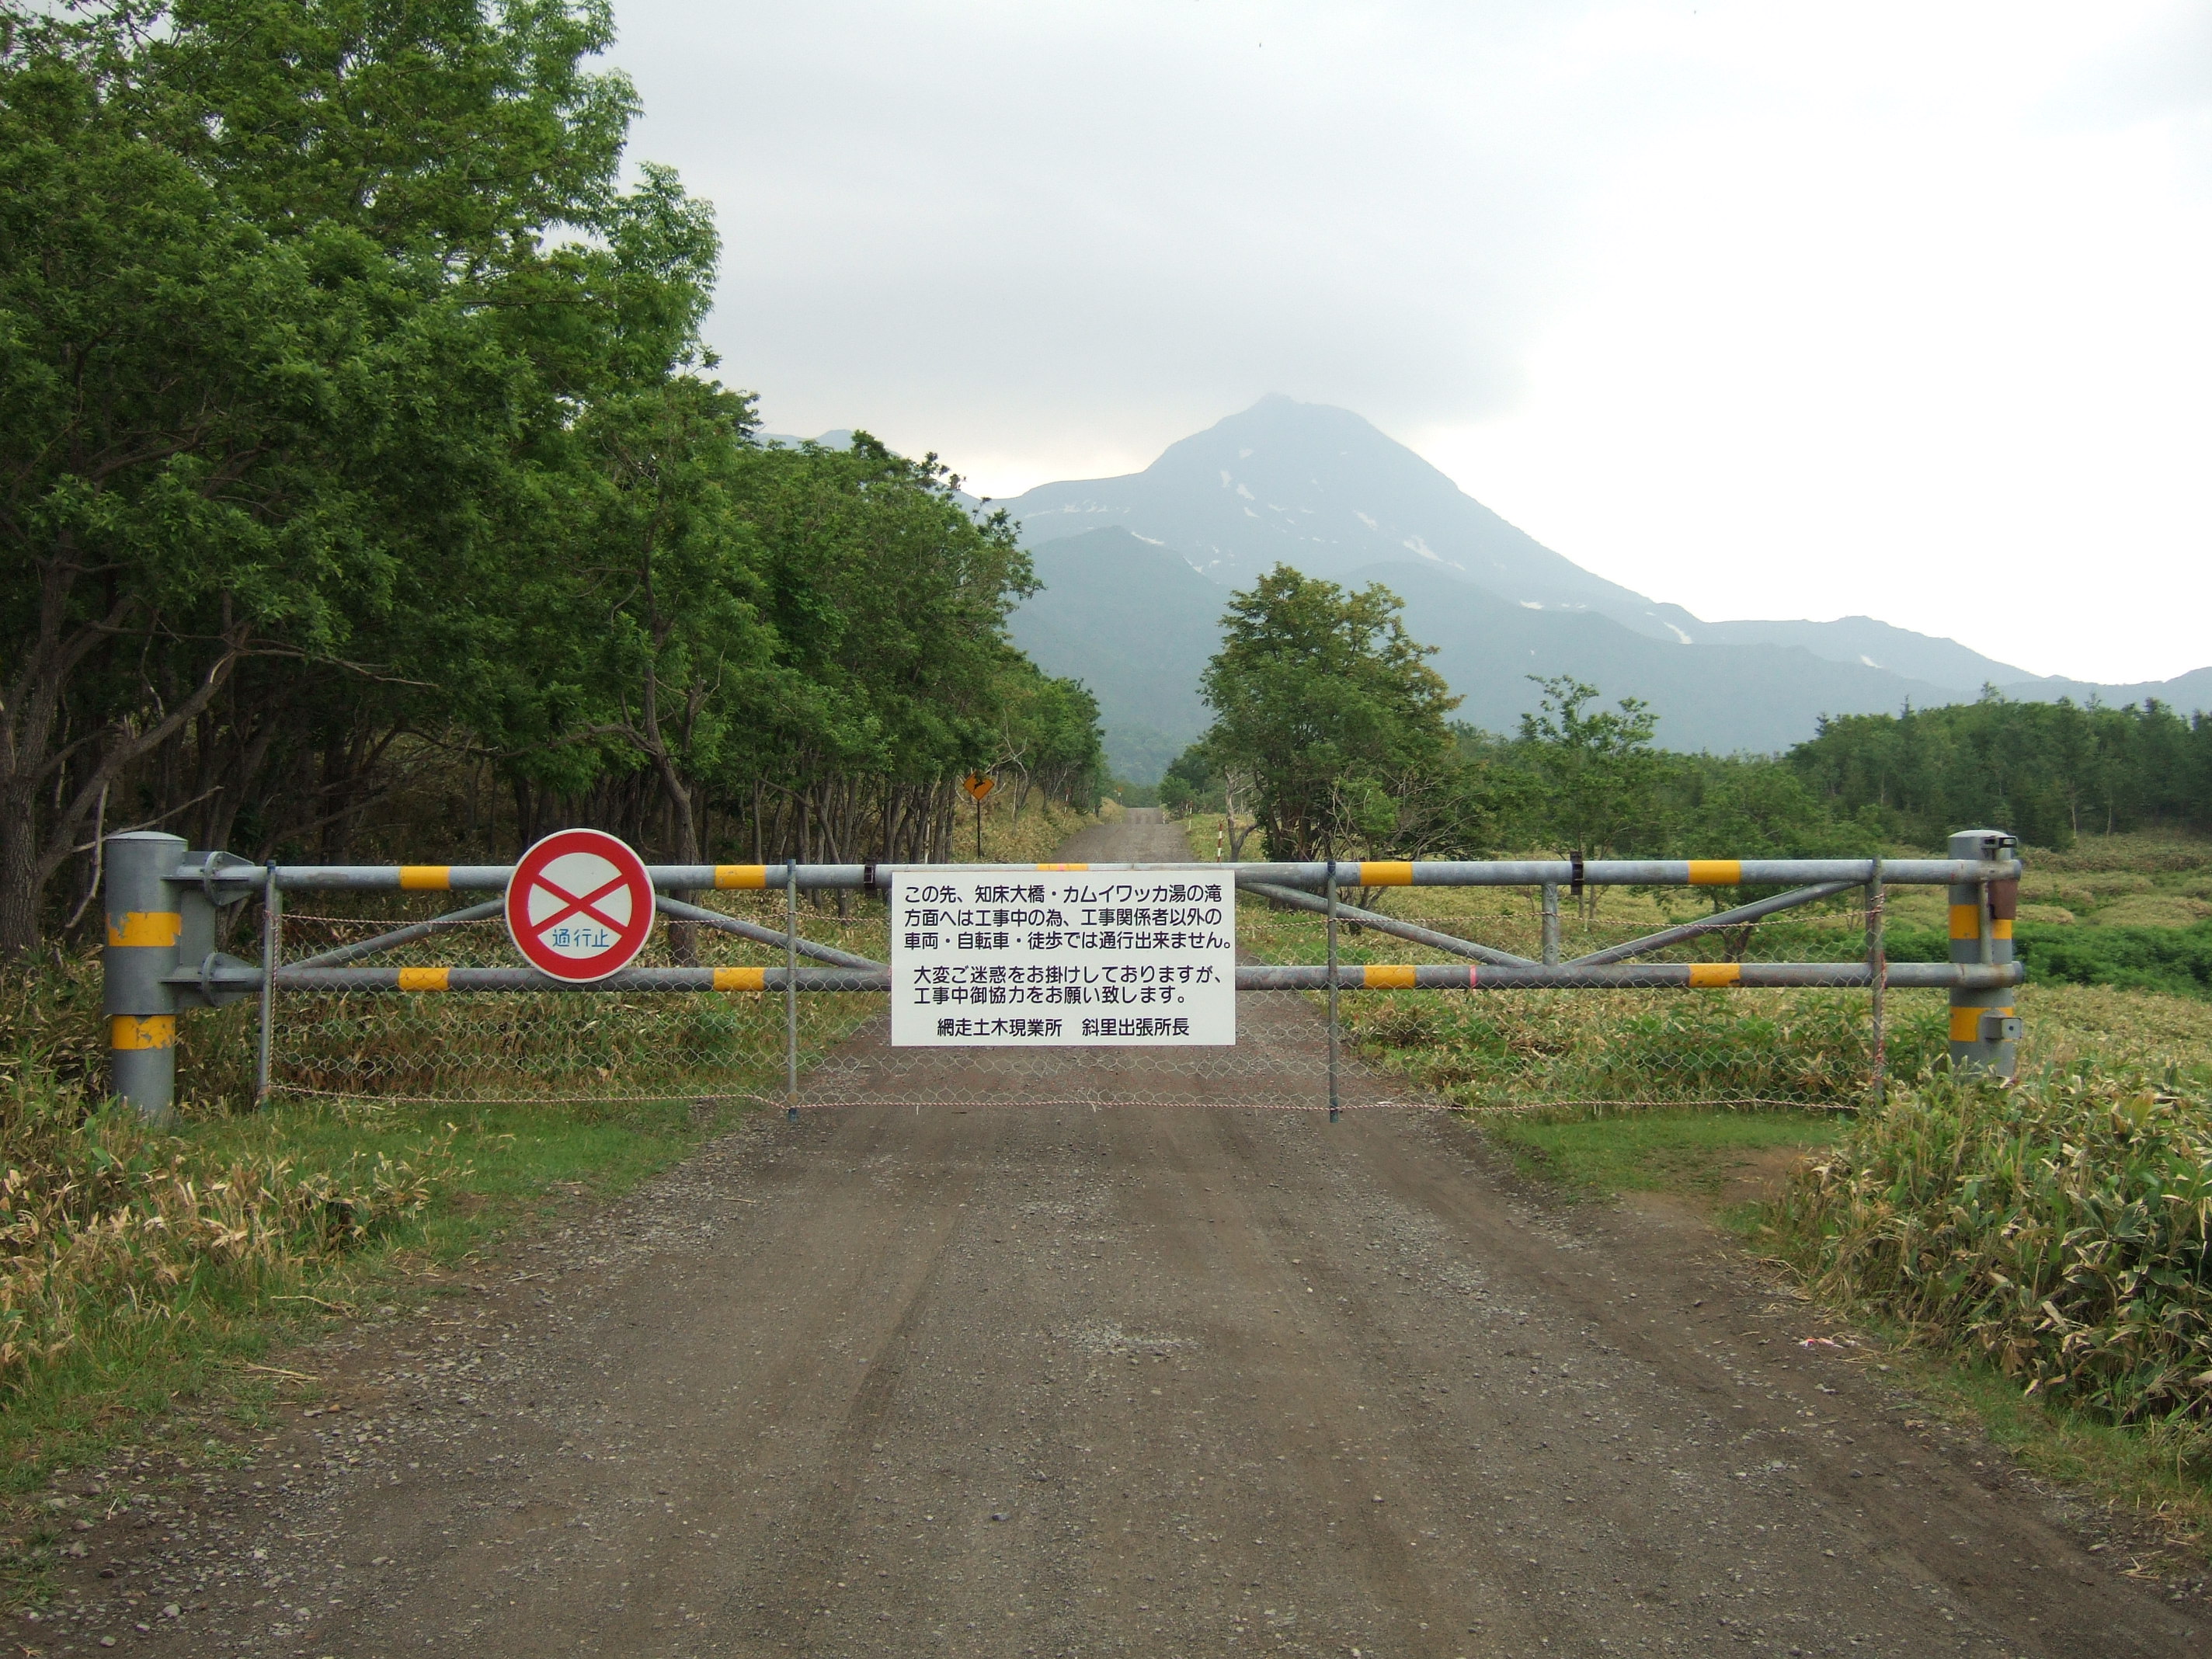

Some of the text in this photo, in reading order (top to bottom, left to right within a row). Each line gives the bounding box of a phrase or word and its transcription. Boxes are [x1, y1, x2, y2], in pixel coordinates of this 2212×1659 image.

[905, 883, 1223, 904] この先、知床大橋・カムイワッカ湯の滝
[904, 907, 1222, 927] 方面へは工事中の為、工事関係者以外の
[552, 928, 610, 948] 通行止
[904, 930, 1231, 951] 車両・自転車・徒歩では通行出来ません。
[913, 965, 1220, 985] 大変ご迷惑をお掛けしておりますが、
[913, 985, 1184, 1005] 工事中御協力をお願い致します。
[937, 1017, 1190, 1037] 網走土木現業所 斜里出張所長
